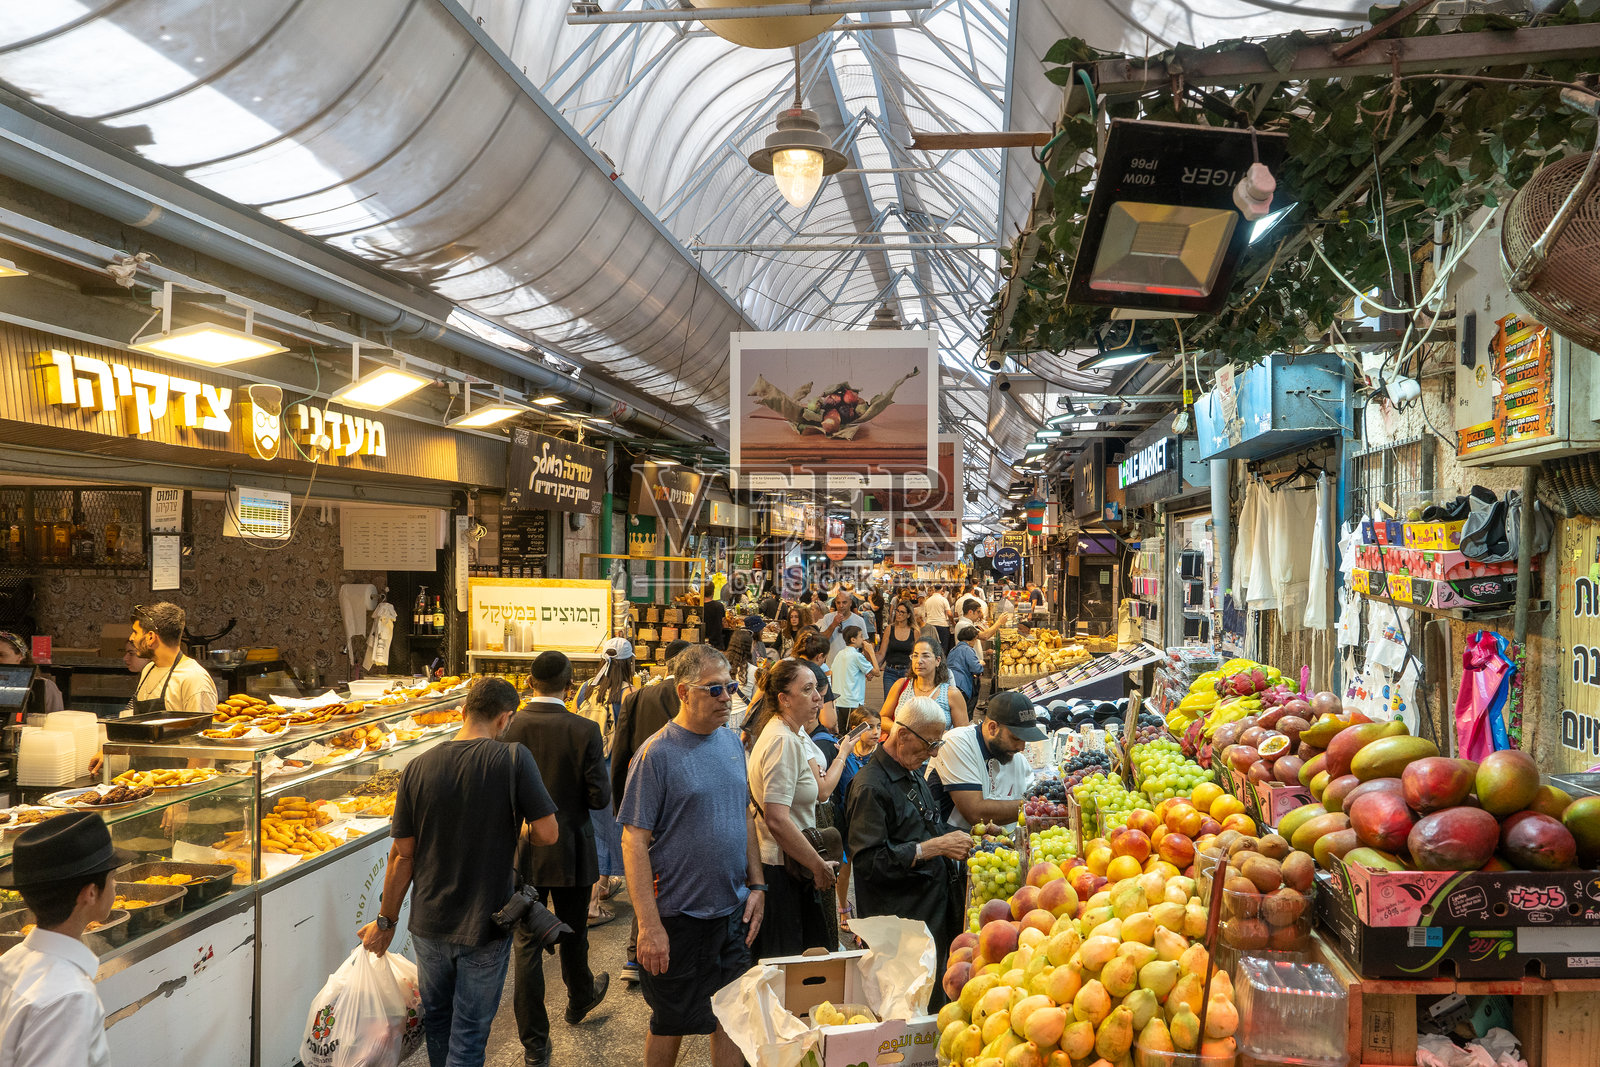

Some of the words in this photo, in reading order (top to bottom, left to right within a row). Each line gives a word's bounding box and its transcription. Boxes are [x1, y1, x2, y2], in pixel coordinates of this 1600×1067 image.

[1130, 158, 1159, 170] IP66
[1122, 173, 1157, 185] 100W
[1181, 166, 1248, 187] IGER
[1505, 365, 1516, 376] Give
[1525, 359, 1539, 371] more
[50, 348, 233, 436] צדקיהו
[1503, 392, 1516, 402] Give
[1522, 387, 1539, 397] more
[296, 403, 387, 458] מעדני
[528, 441, 563, 491] המלך
[1138, 436, 1168, 481] MARKET
[563, 458, 593, 484] טחינה
[156, 489, 179, 502] חומוס
[155, 501, 178, 514] צדקיהו
